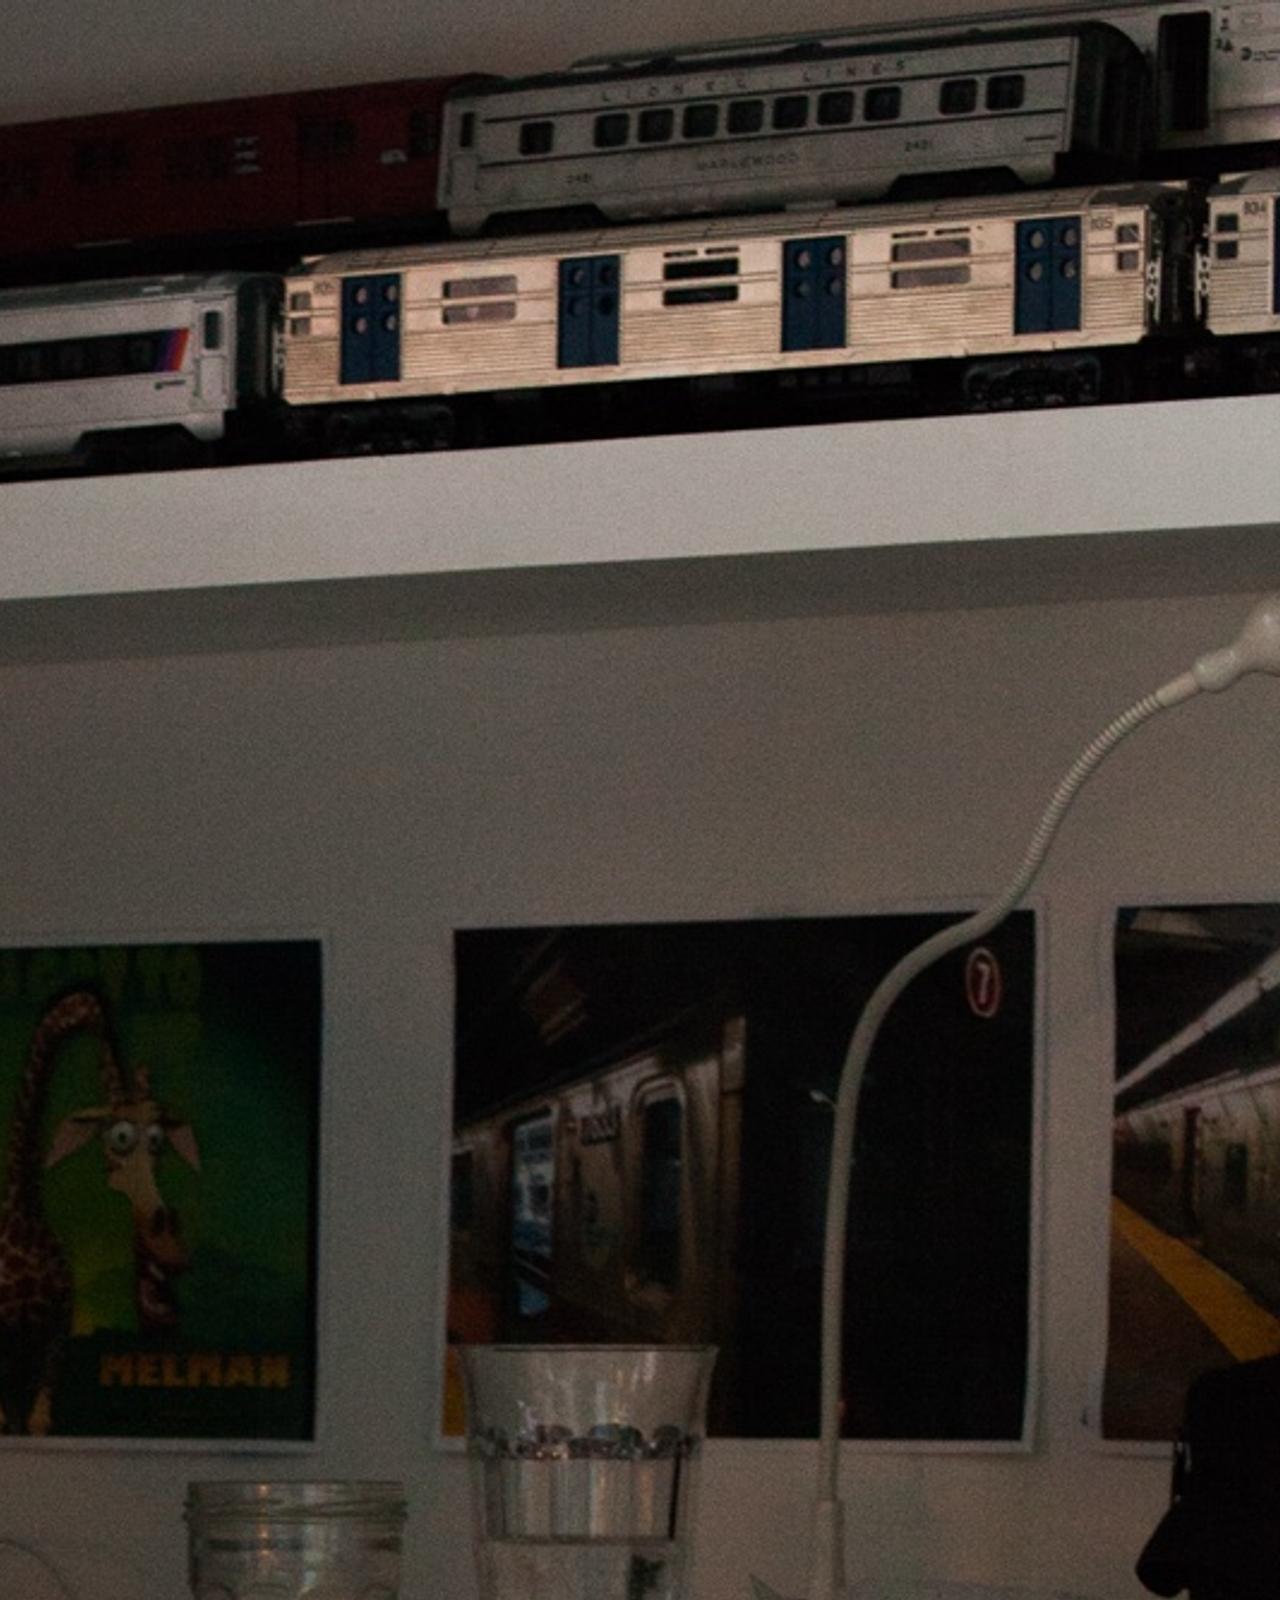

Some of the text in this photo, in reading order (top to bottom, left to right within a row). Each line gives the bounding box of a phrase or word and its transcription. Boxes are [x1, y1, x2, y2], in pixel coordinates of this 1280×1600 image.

[600, 59, 906, 103] LIONEL LINES
[975, 959, 993, 1006] 7
[98, 1351, 291, 1390] MELMAN
